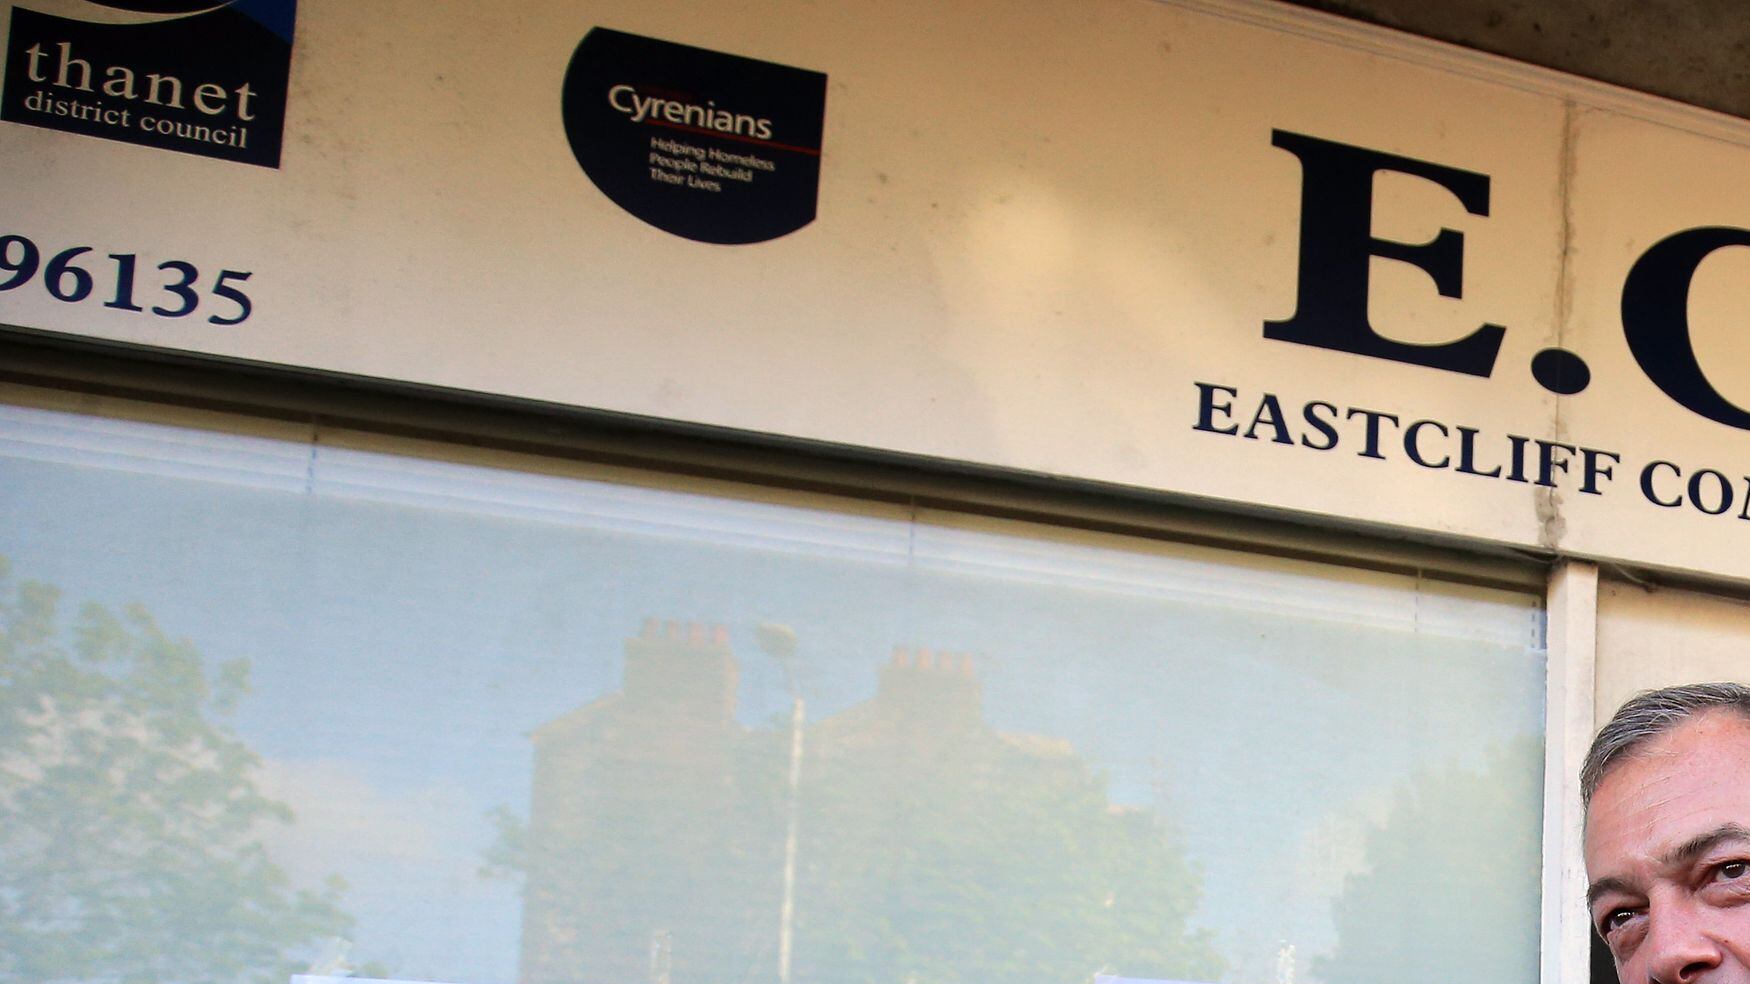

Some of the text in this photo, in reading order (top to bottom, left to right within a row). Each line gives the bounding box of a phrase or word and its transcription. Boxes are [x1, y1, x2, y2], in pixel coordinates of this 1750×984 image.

[25, 42, 258, 121] thanet
[24, 90, 247, 148] district council
[608, 84, 773, 140] Cyrenians
[649, 152, 753, 182] People Rebuild
[650, 136, 776, 171] Helping Homeless
[687, 175, 721, 192] Lives
[0, 234, 253, 326] 96135
[1192, 380, 1622, 496] EASTCLIFF
